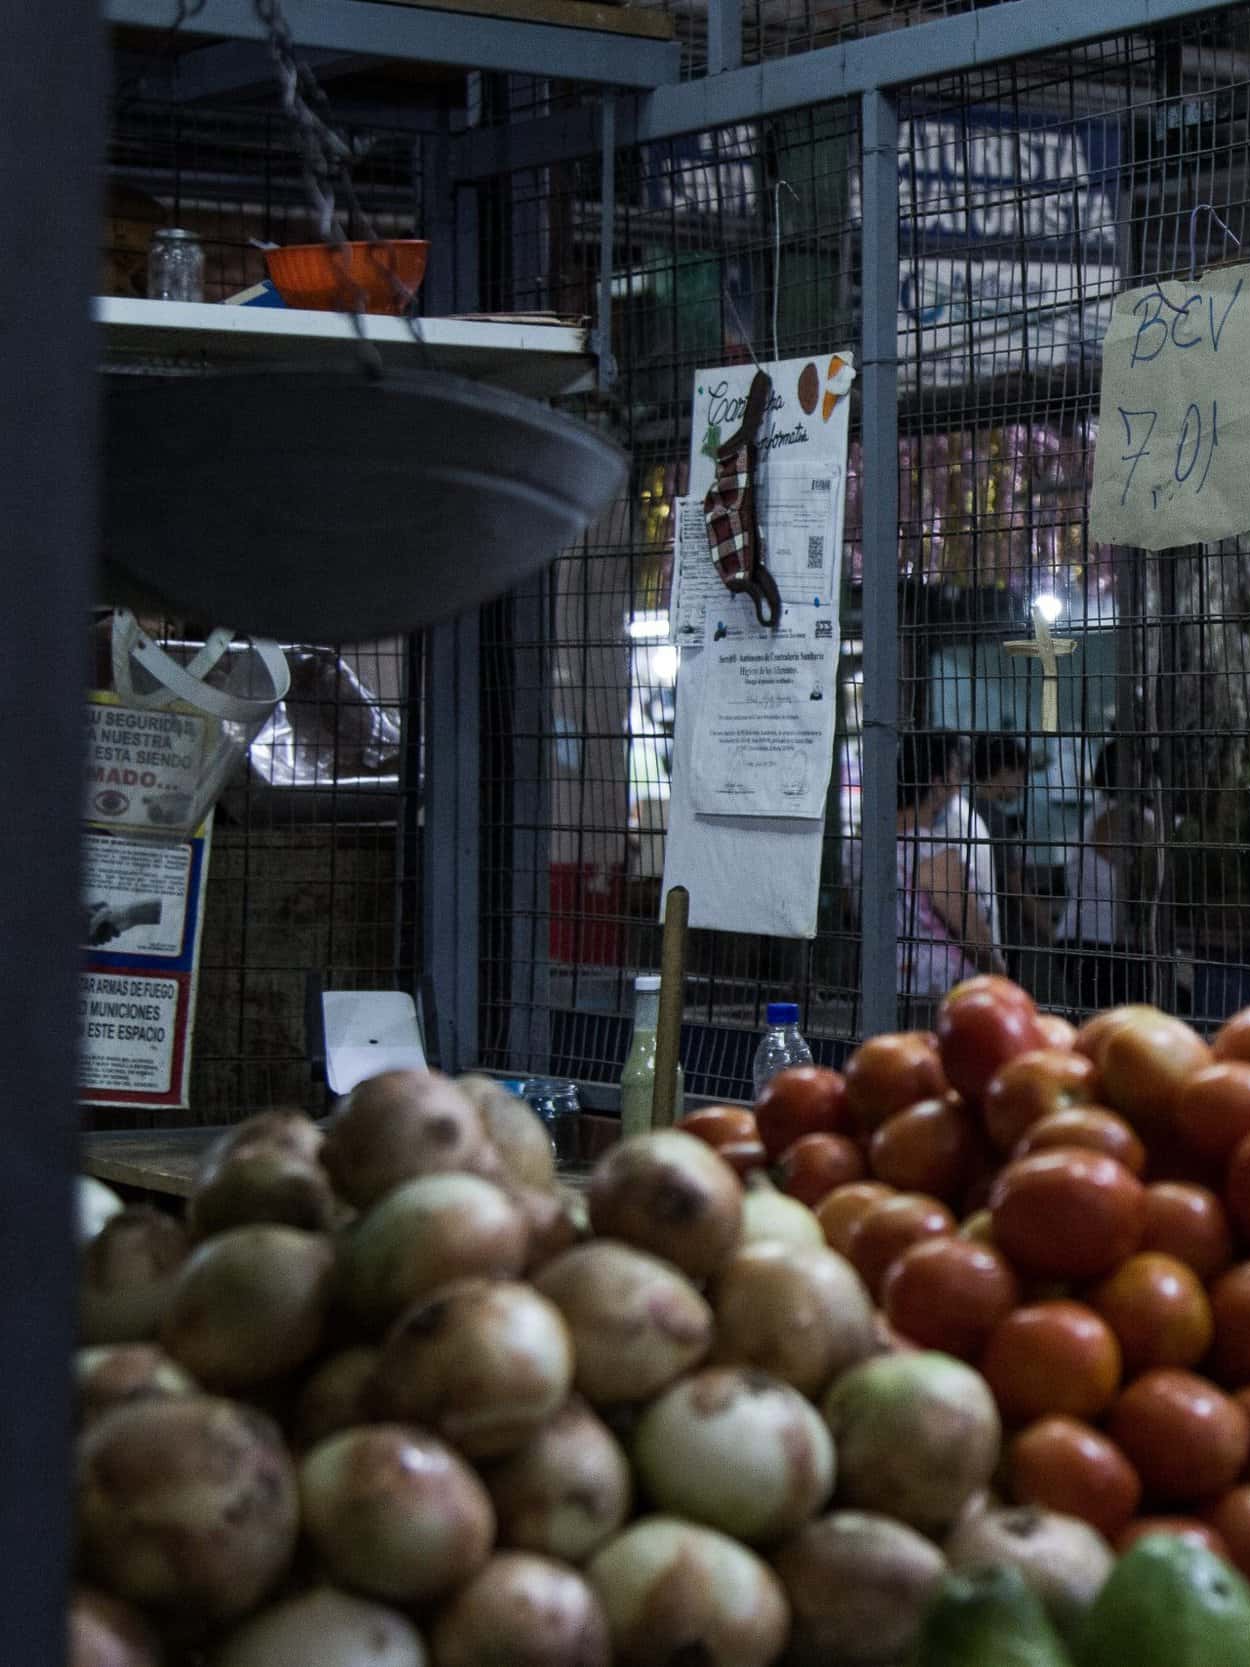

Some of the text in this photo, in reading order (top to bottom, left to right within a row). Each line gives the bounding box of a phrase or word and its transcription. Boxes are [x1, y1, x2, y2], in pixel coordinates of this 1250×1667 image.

[101, 728, 171, 750] NUESTRA
[95, 745, 191, 769] ESTA SIENDO
[96, 979, 129, 996] ARMAS
[129, 982, 143, 997] DE
[144, 982, 175, 999] FUEGO
[90, 1000, 160, 1021] MUNICIONES
[87, 1022, 165, 1043] ESTE ESPACIO
